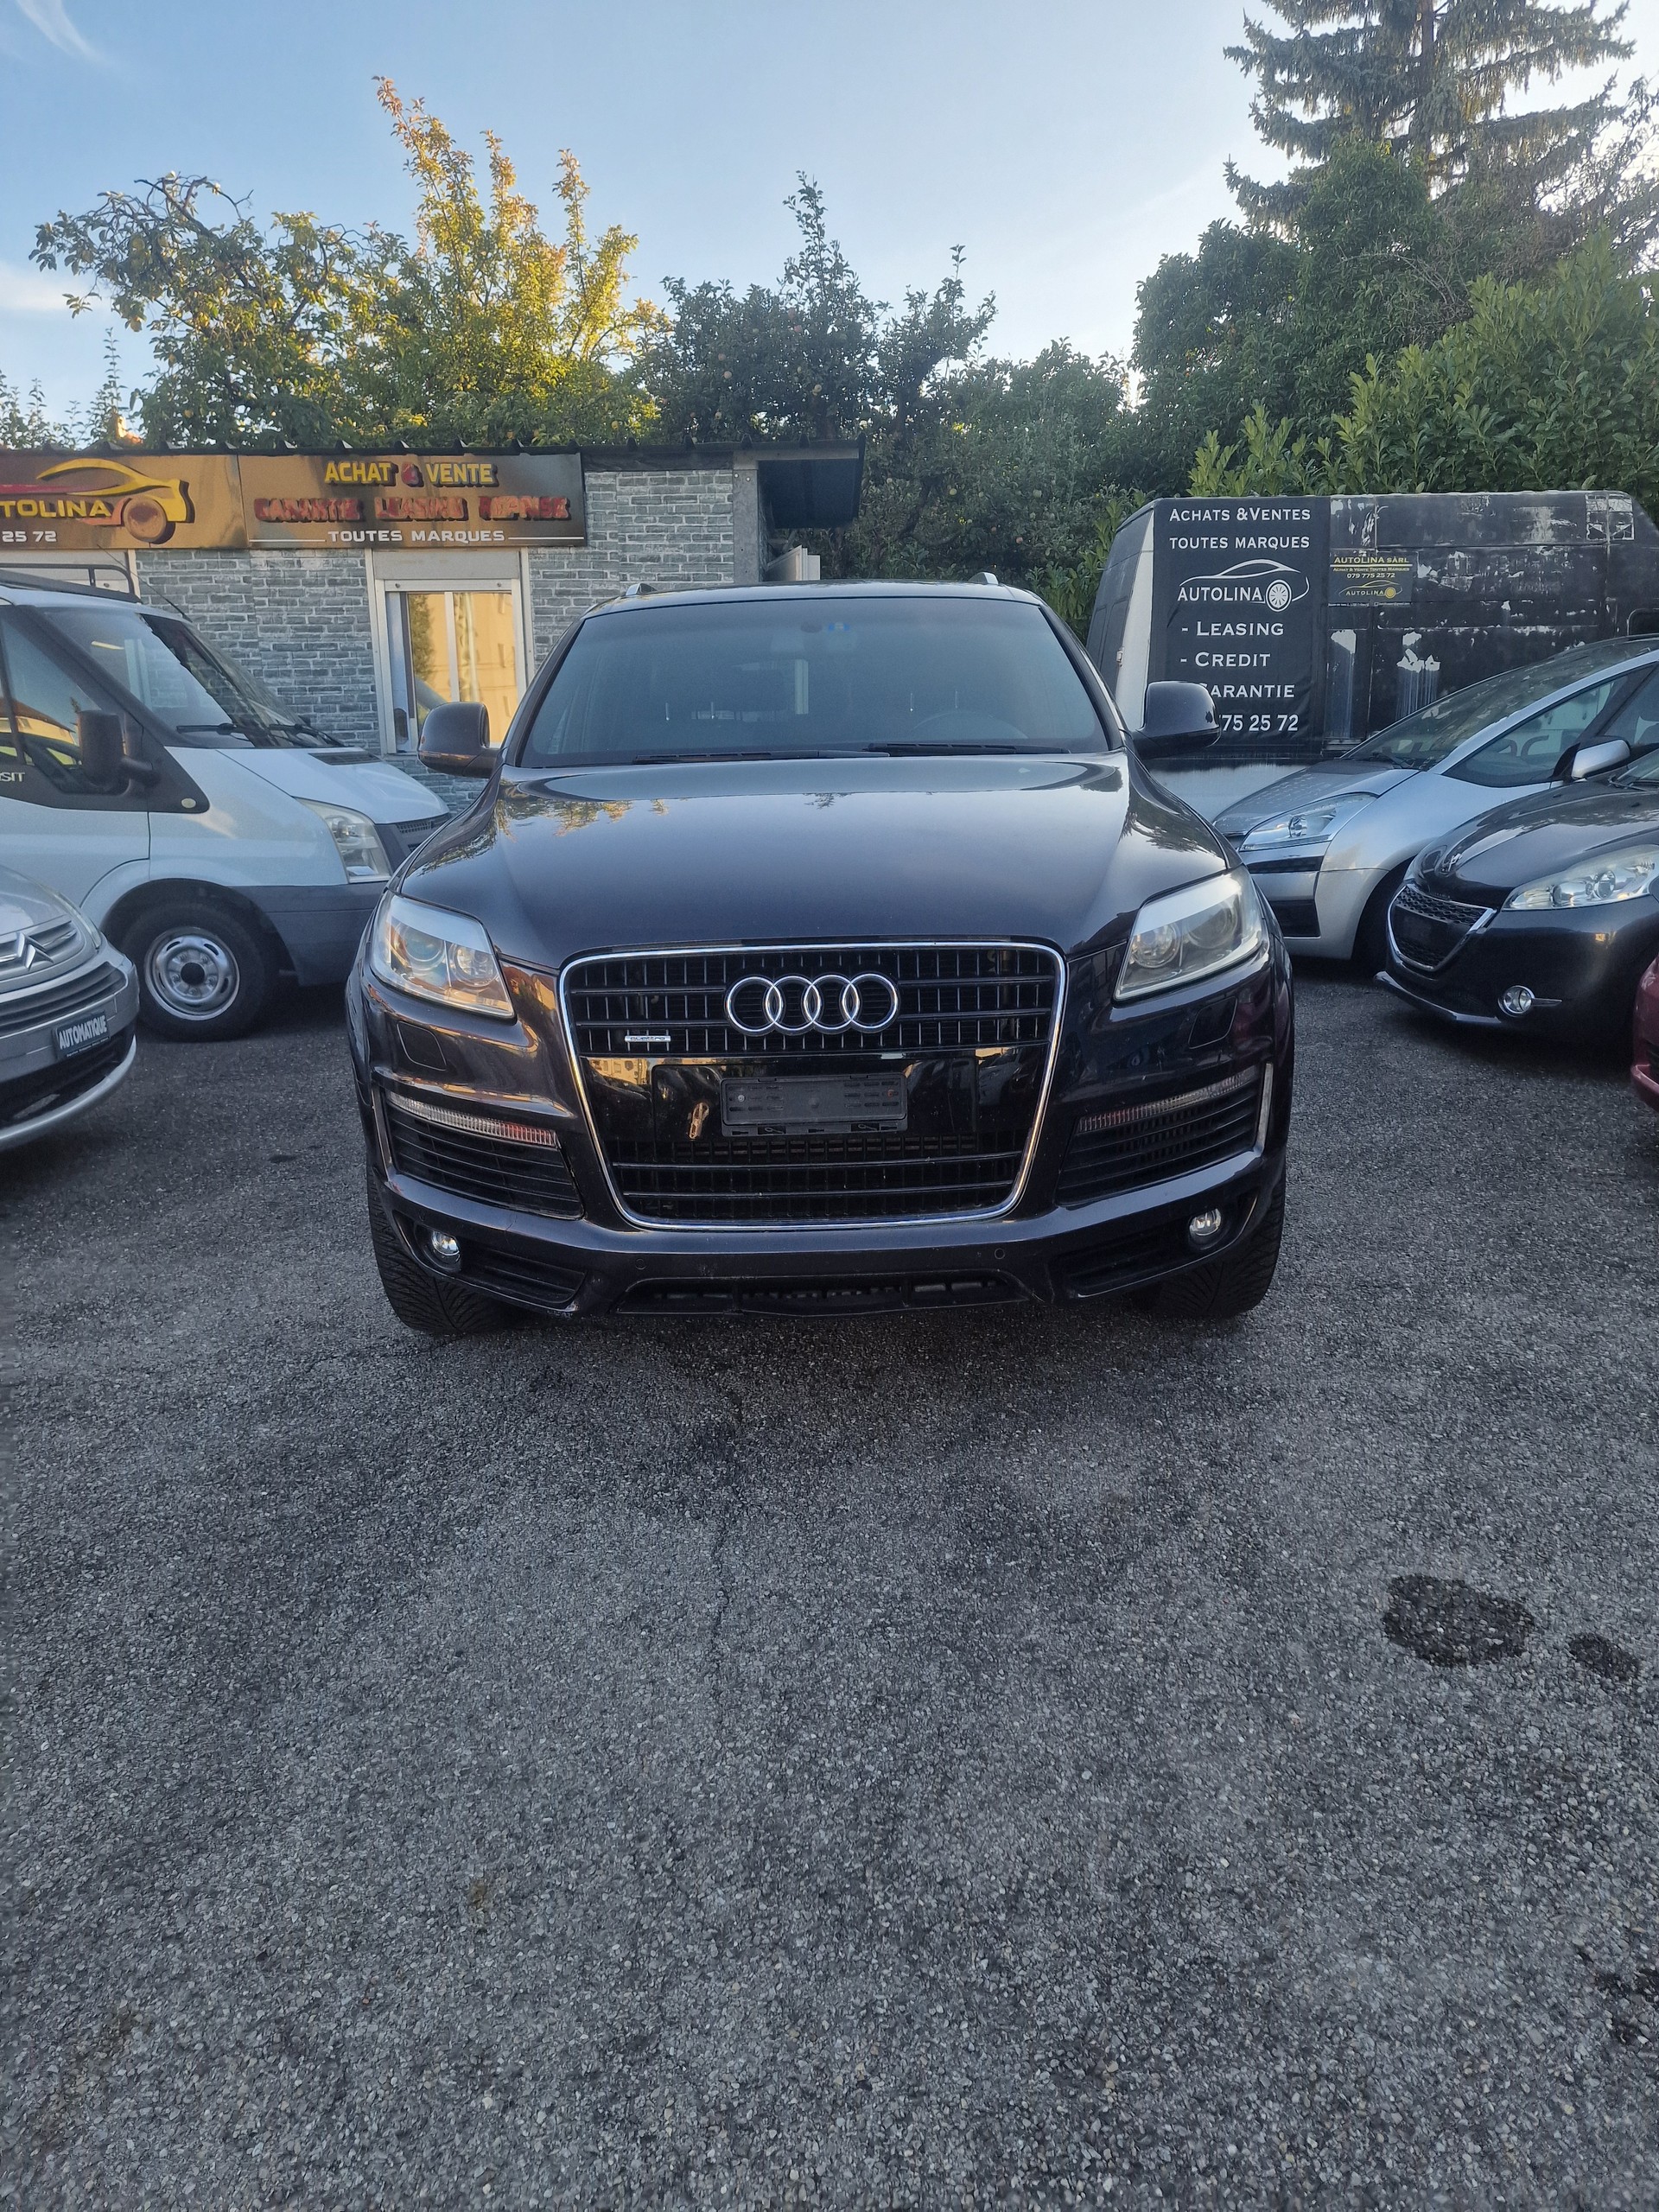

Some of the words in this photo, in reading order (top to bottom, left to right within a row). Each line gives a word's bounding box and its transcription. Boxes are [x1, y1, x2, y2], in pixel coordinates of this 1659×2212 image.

[324, 462, 392, 483] ACHAT
[425, 463, 497, 484] VENTE
[0, 499, 112, 518] TOLINA
[1169, 508, 1230, 522] ACHATS
[2, 531, 28, 543] 25
[32, 531, 57, 543] 72
[327, 530, 404, 543] TOUTES
[411, 530, 505, 544] MARQUES
[1169, 537, 1229, 550] TOUTES
[1235, 536, 1310, 550] MARQUES
[1178, 587, 1263, 601] AUTOLINA
[1196, 620, 1285, 636] LEASING
[1195, 652, 1271, 667] CREDIT
[1199, 683, 1295, 698] ARANTIE
[1219, 714, 1243, 732] 75
[1249, 714, 1271, 732] 25
[1277, 714, 1299, 732] 72
[0, 772, 26, 782] SIT
[59, 1014, 107, 1050] AUTOMATIQUE
